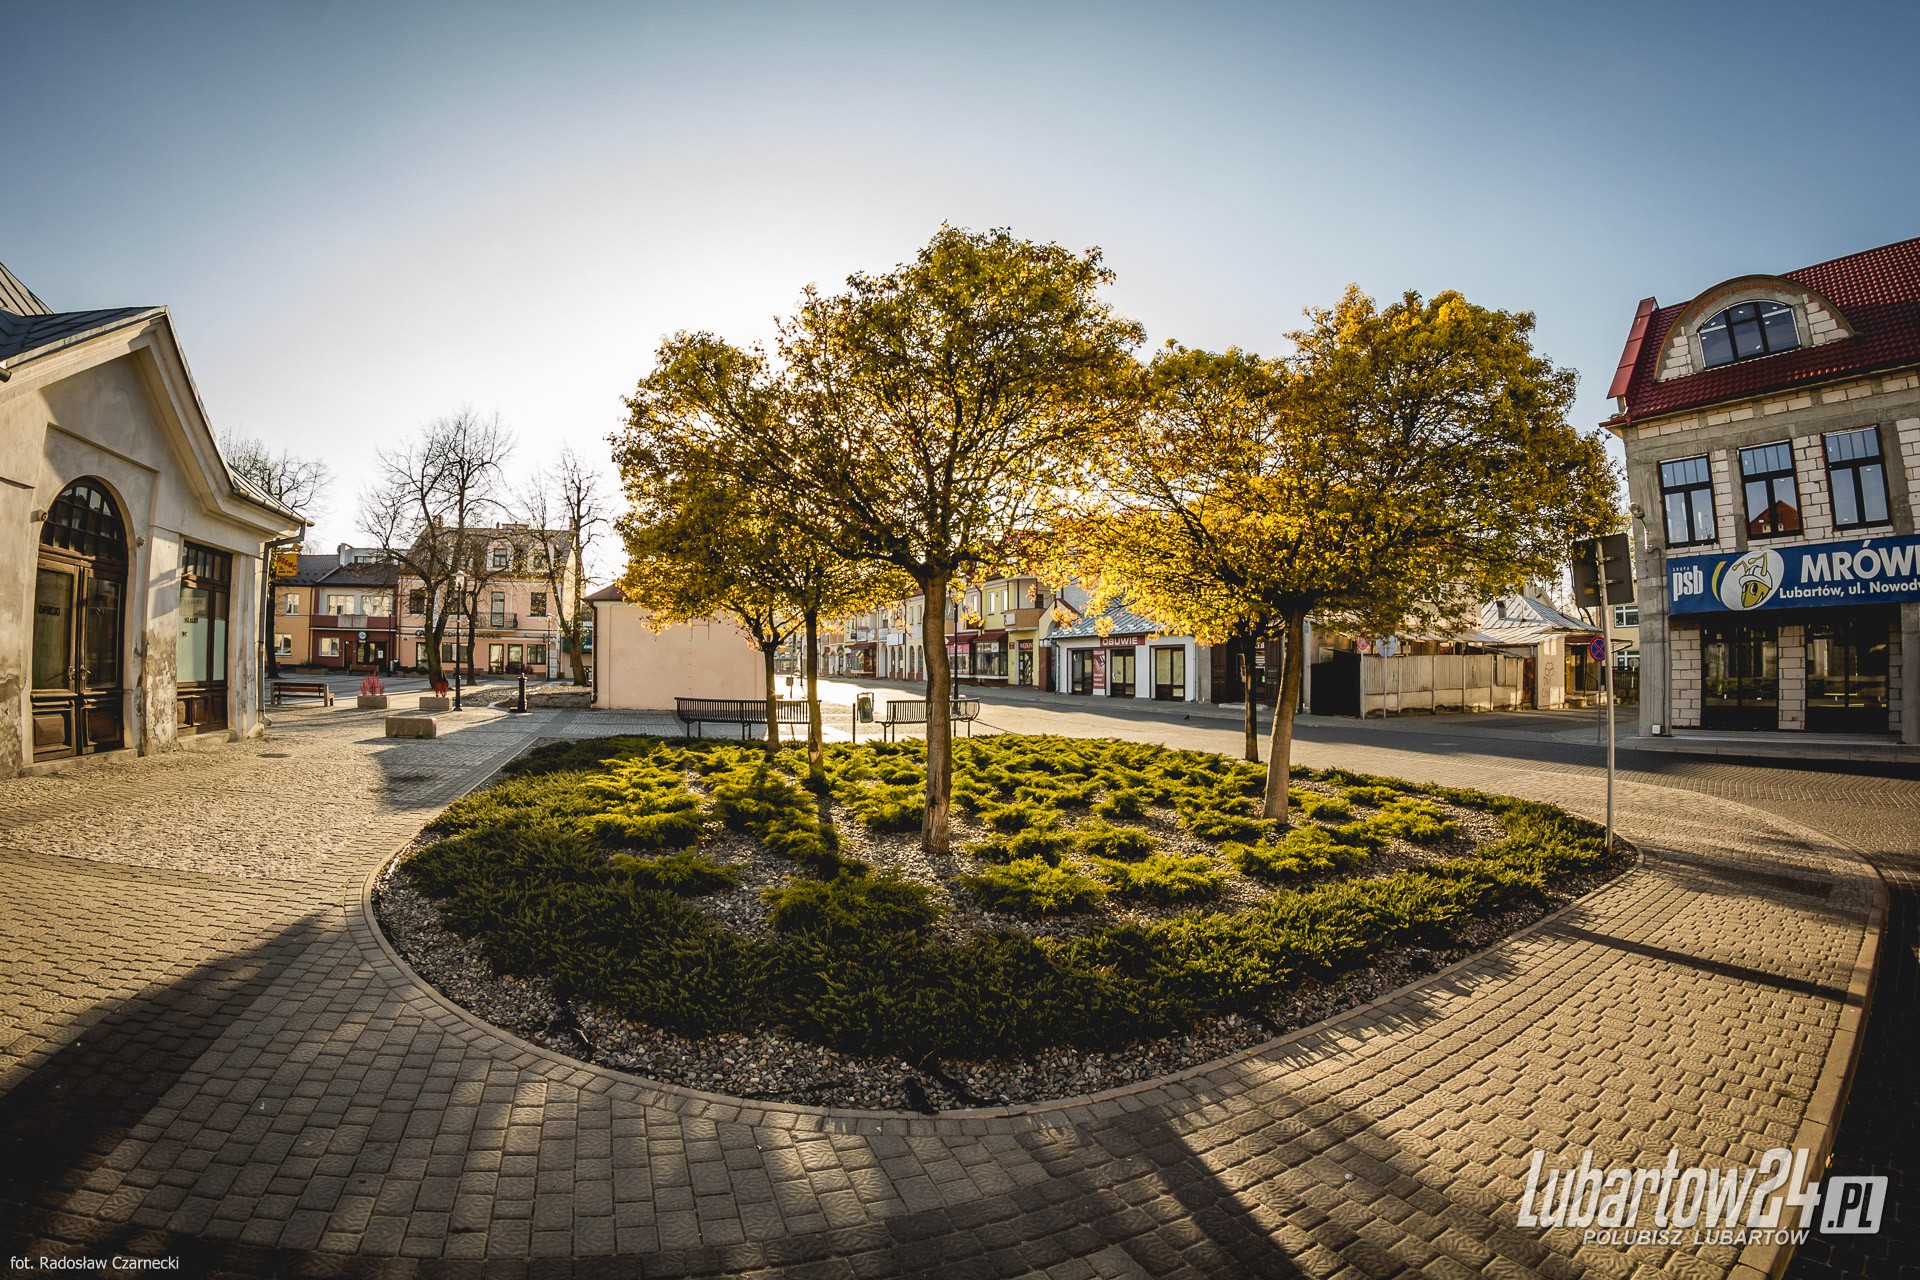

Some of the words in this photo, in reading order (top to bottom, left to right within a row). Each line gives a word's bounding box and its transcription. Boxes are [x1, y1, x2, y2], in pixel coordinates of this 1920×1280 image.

[1672, 565, 1704, 602] psb
[1779, 586, 1845, 600] Lubartów,
[1848, 582, 1865, 594] ul.
[461, 631, 501, 639] ARICOLE
[1102, 637, 1138, 646] OBUWIE
